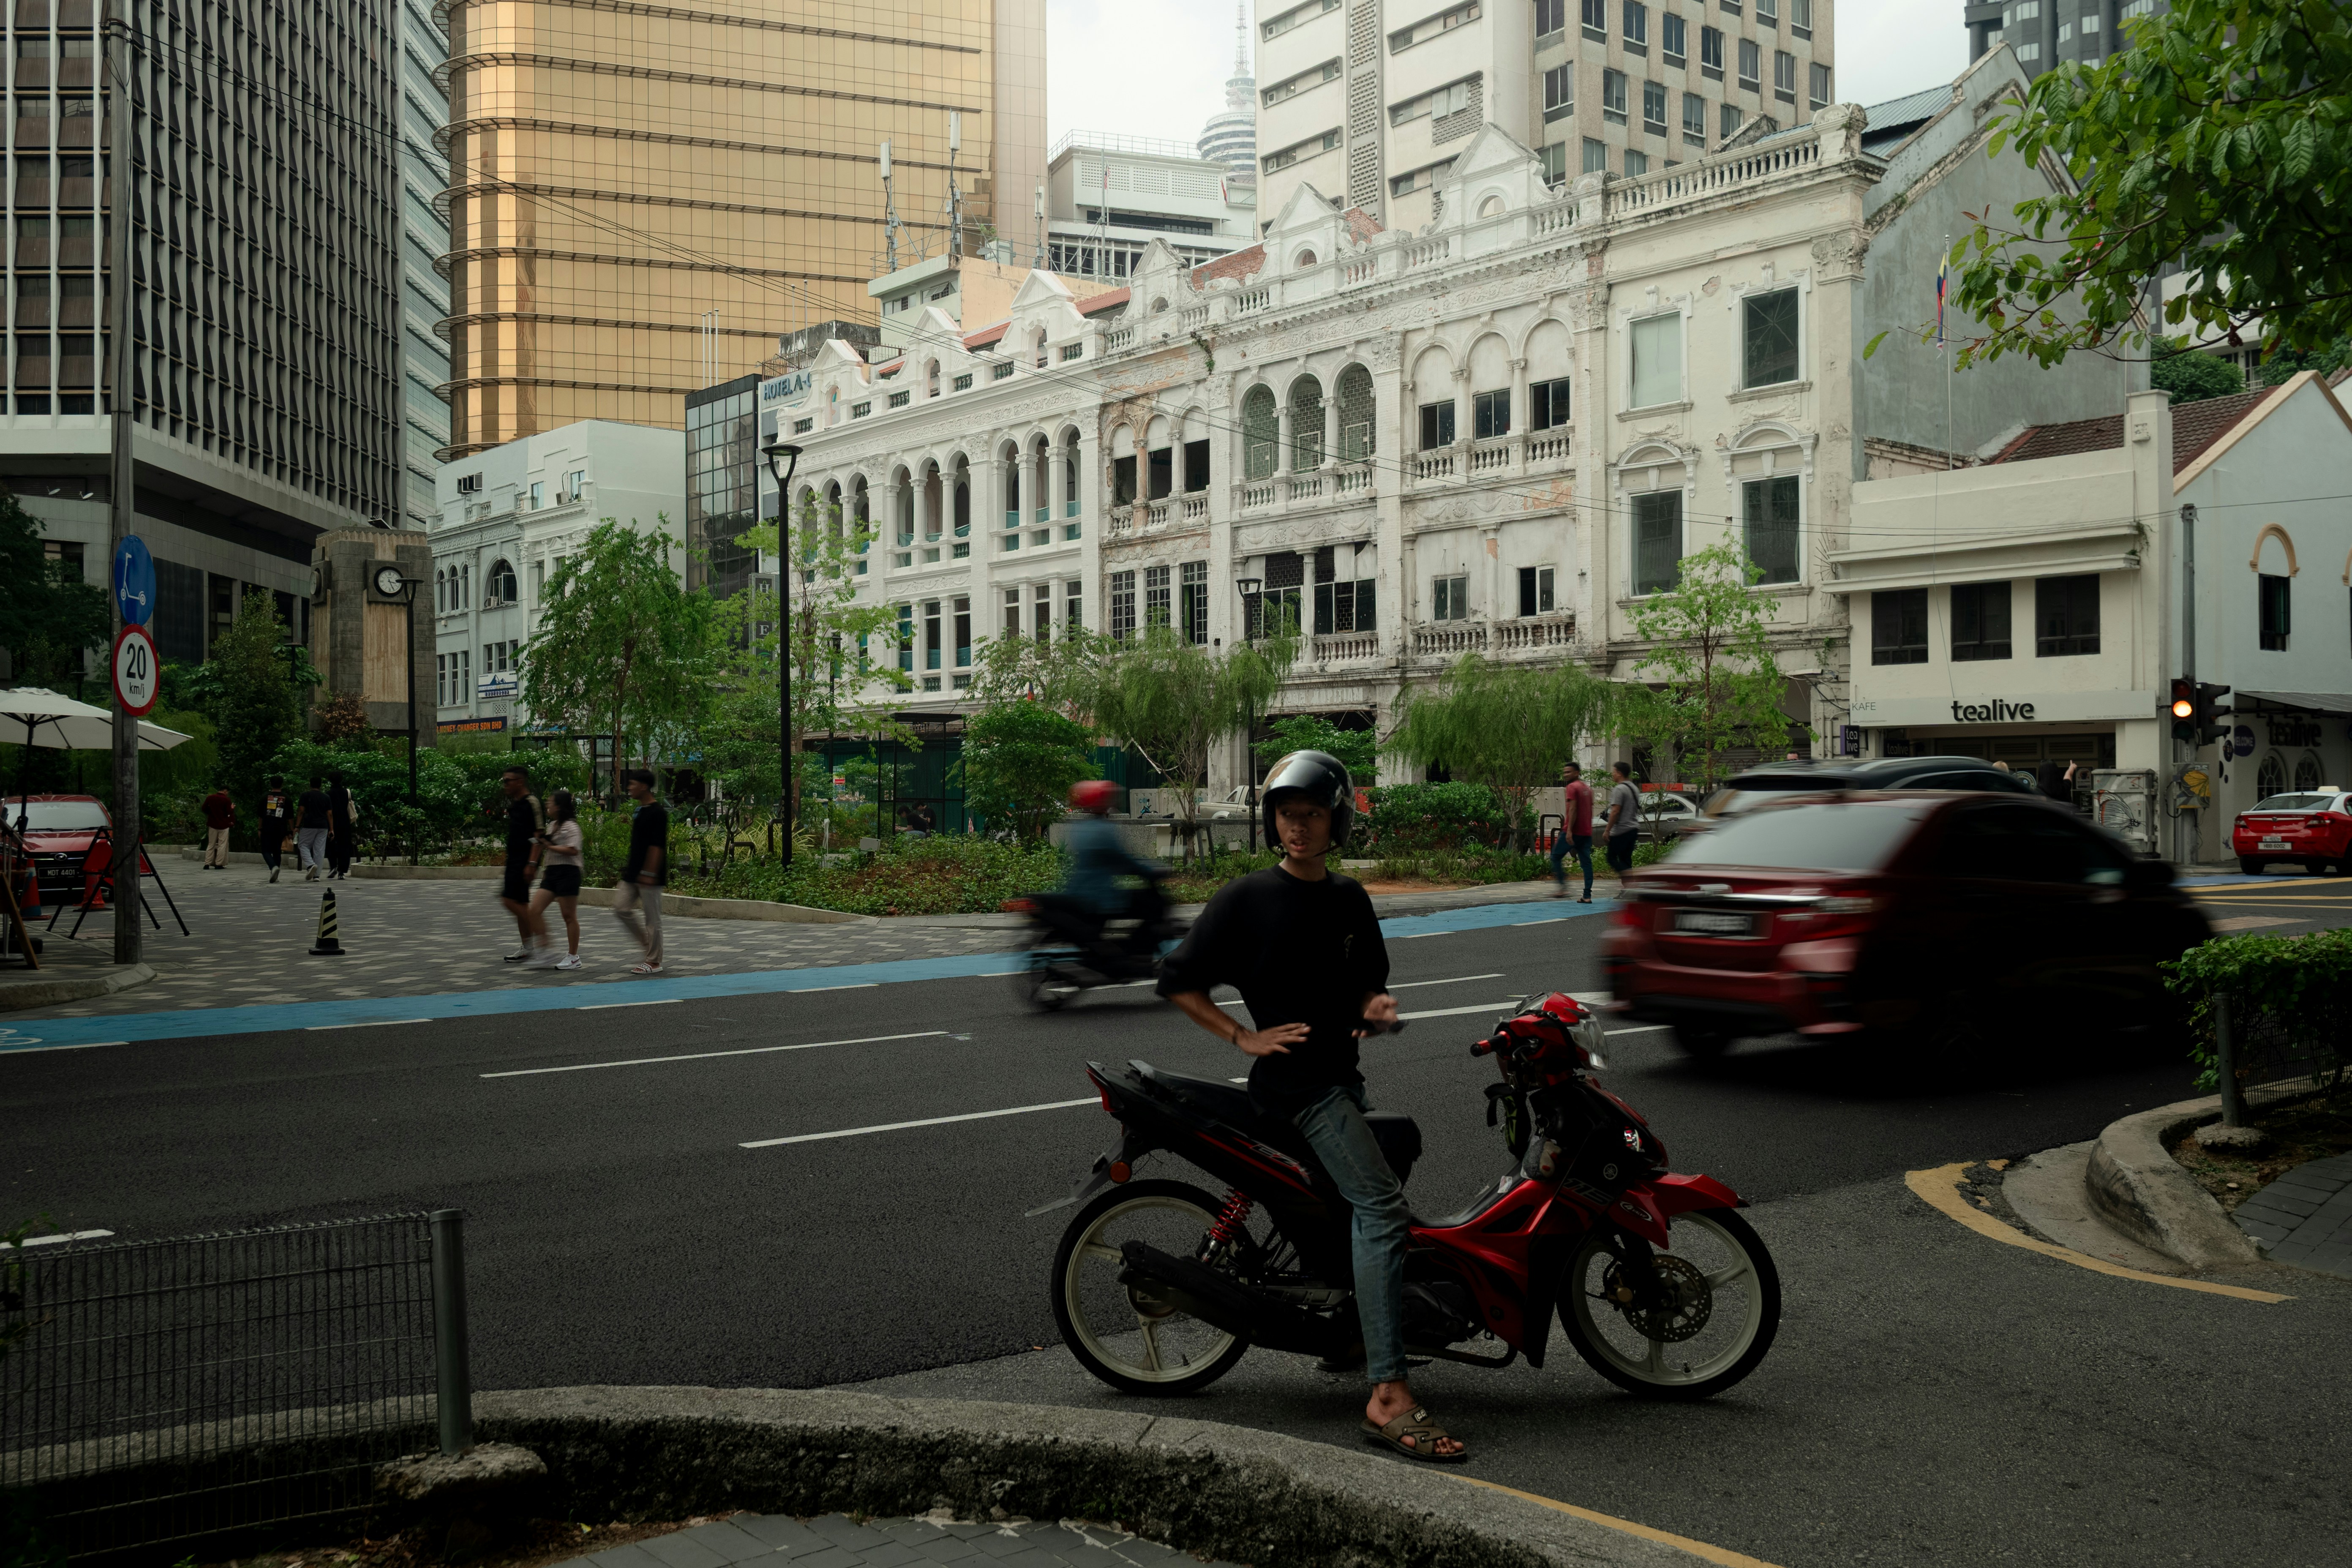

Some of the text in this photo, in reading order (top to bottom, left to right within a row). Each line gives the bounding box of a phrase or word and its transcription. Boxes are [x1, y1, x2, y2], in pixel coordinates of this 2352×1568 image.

[763, 377, 793, 401] HOTEL
[126, 643, 146, 680] 20
[129, 682, 144, 698] km/j
[1852, 702, 1876, 711] KAFE
[1951, 698, 2035, 722] tealive
[457, 723, 479, 732] CHANGER
[480, 722, 491, 731] SDN
[491, 721, 502, 730] BHD
[1845, 728, 1858, 740] tea
[1846, 740, 1858, 752] live
[1887, 743, 1909, 755] tealive
